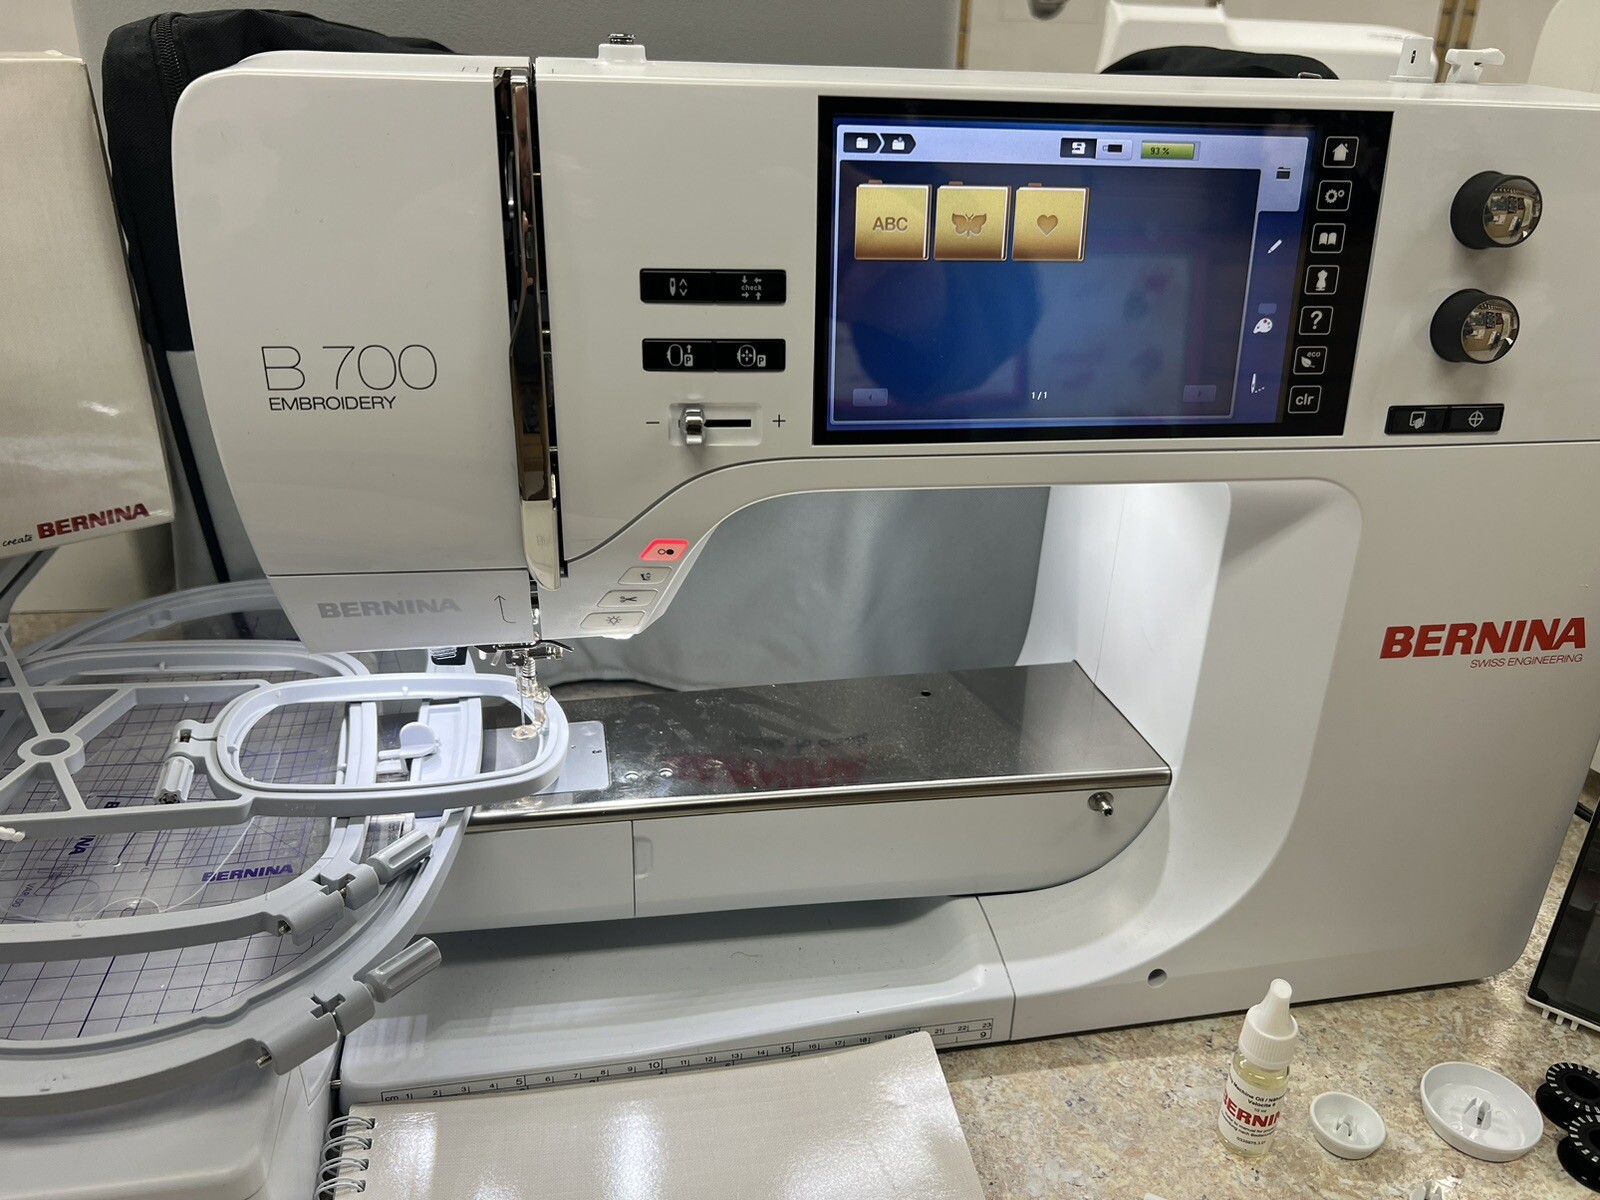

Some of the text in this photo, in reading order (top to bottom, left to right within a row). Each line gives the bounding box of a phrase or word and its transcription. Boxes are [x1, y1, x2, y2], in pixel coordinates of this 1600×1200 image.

[872, 216, 908, 232] ABC
[261, 344, 438, 391] B 700
[268, 396, 397, 411] EMBROIDERY
[1295, 393, 1314, 405] clr
[2, 502, 150, 547] create BERNINA
[317, 598, 463, 619] BERNINA
[1380, 617, 1586, 659] BERNINA
[1469, 653, 1584, 669] SWISS ENGINEERING
[201, 864, 294, 882] BERNINA
[515, 1077, 523, 1086] 5
[648, 1061, 660, 1069] 10
[780, 1045, 791, 1053] 15
